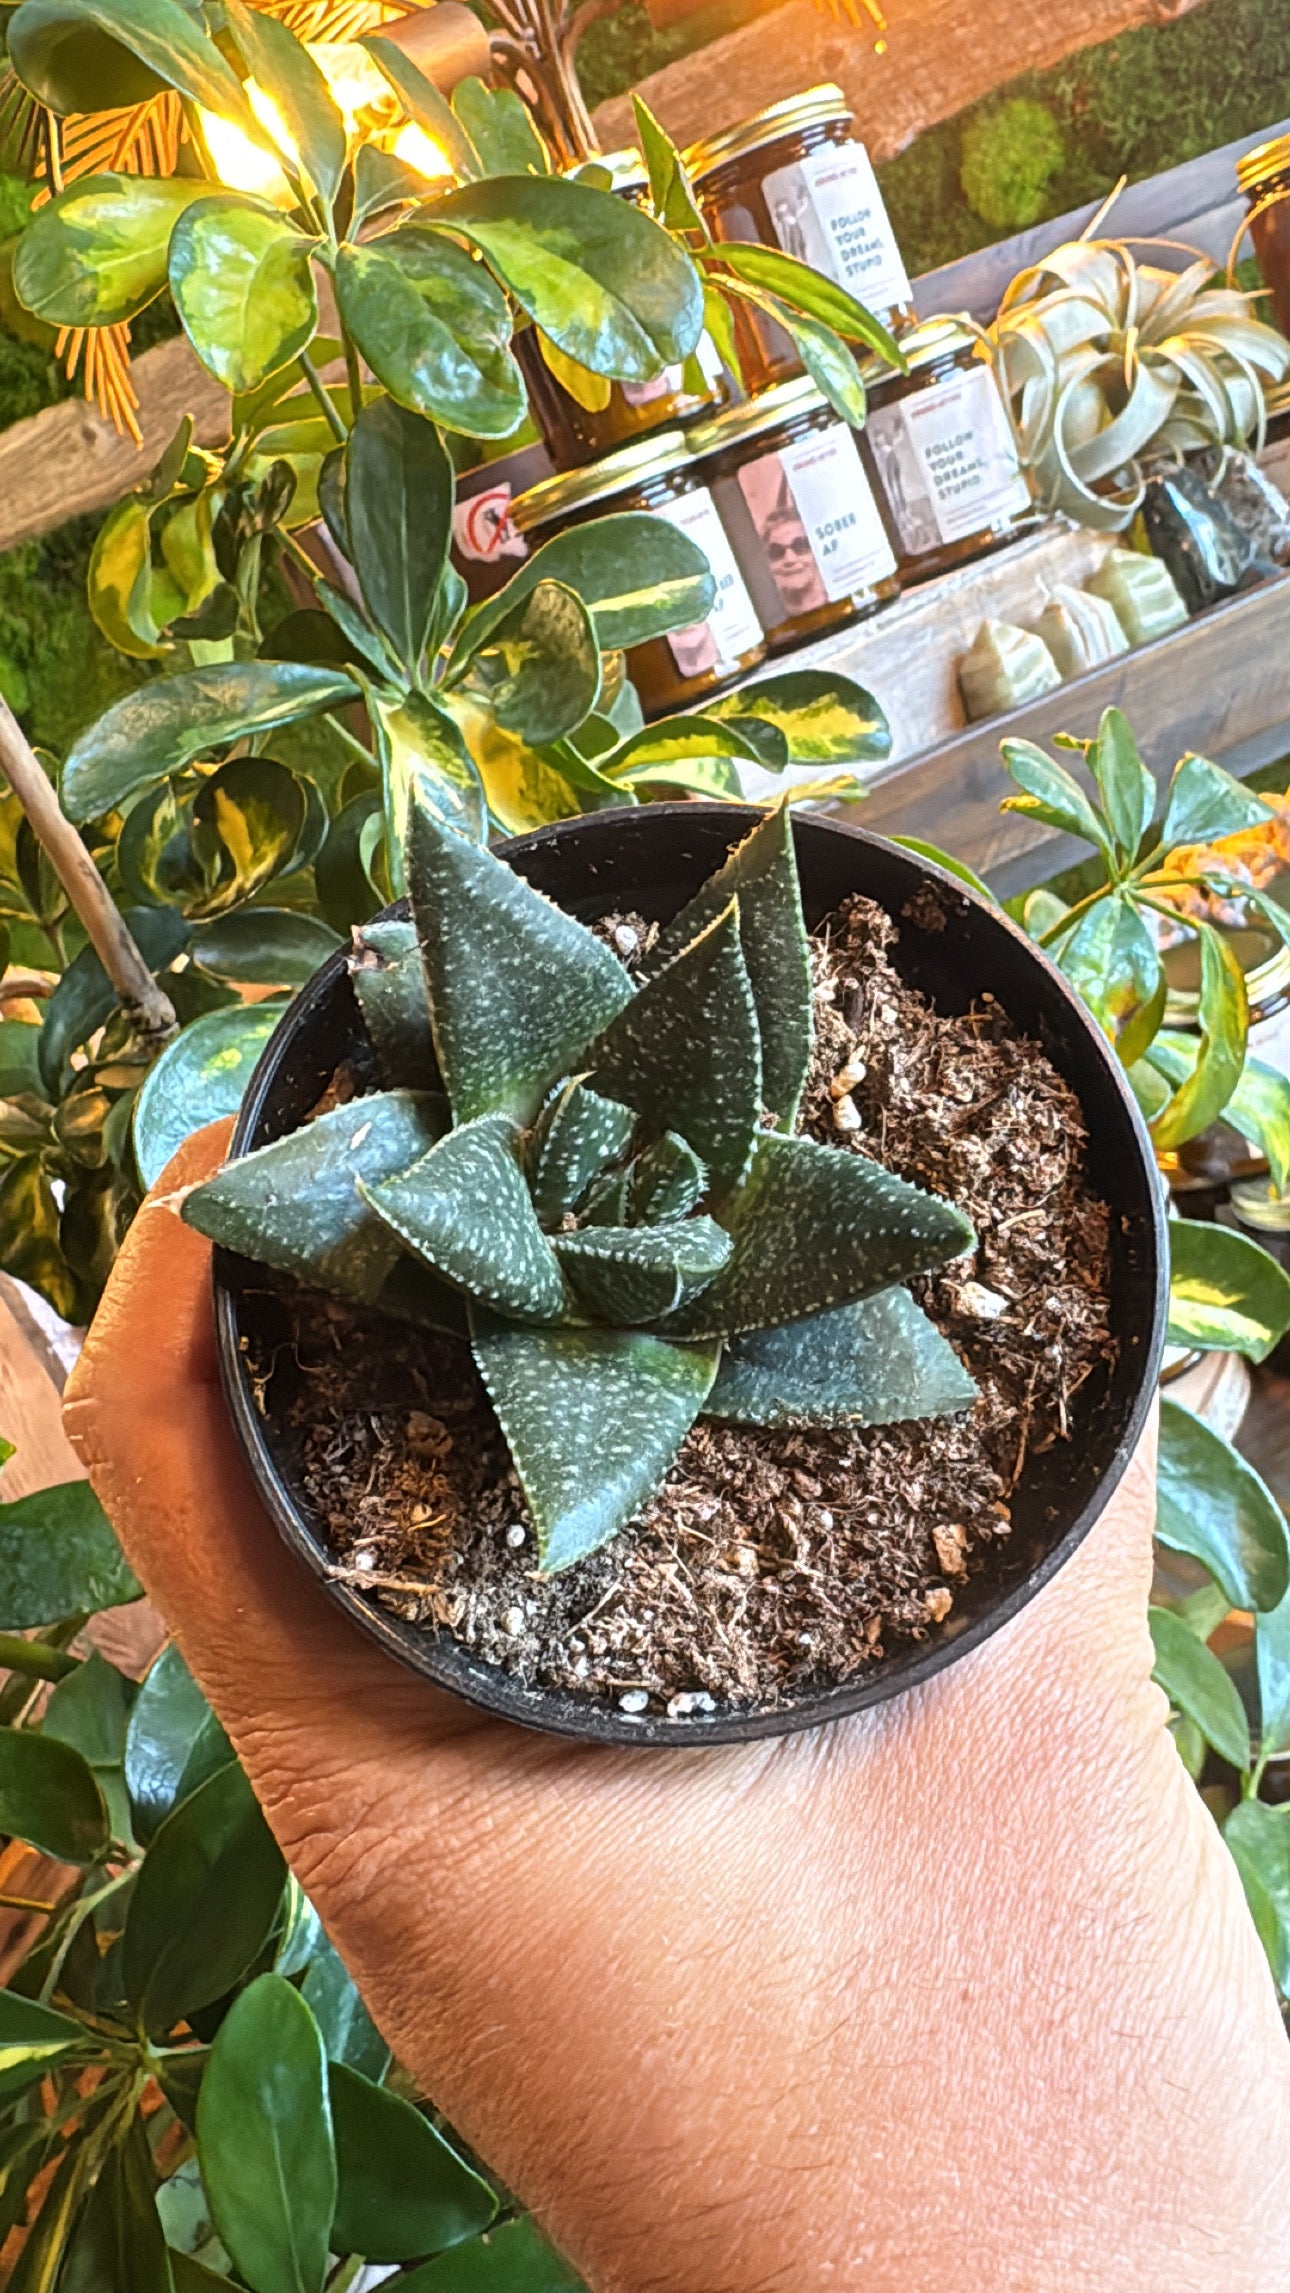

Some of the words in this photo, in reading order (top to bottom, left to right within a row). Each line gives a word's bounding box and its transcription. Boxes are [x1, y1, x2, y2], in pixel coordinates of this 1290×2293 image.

[831, 208, 870, 231] FOLLOW
[835, 227, 865, 246] YOUR
[845, 255, 882, 278] STUPID
[925, 431, 973, 458] FOLLOW
[929, 451, 963, 471] YOUR
[938, 475, 980, 500] STUPID
[815, 512, 856, 540] SOBER
[823, 539, 838, 557] AF
